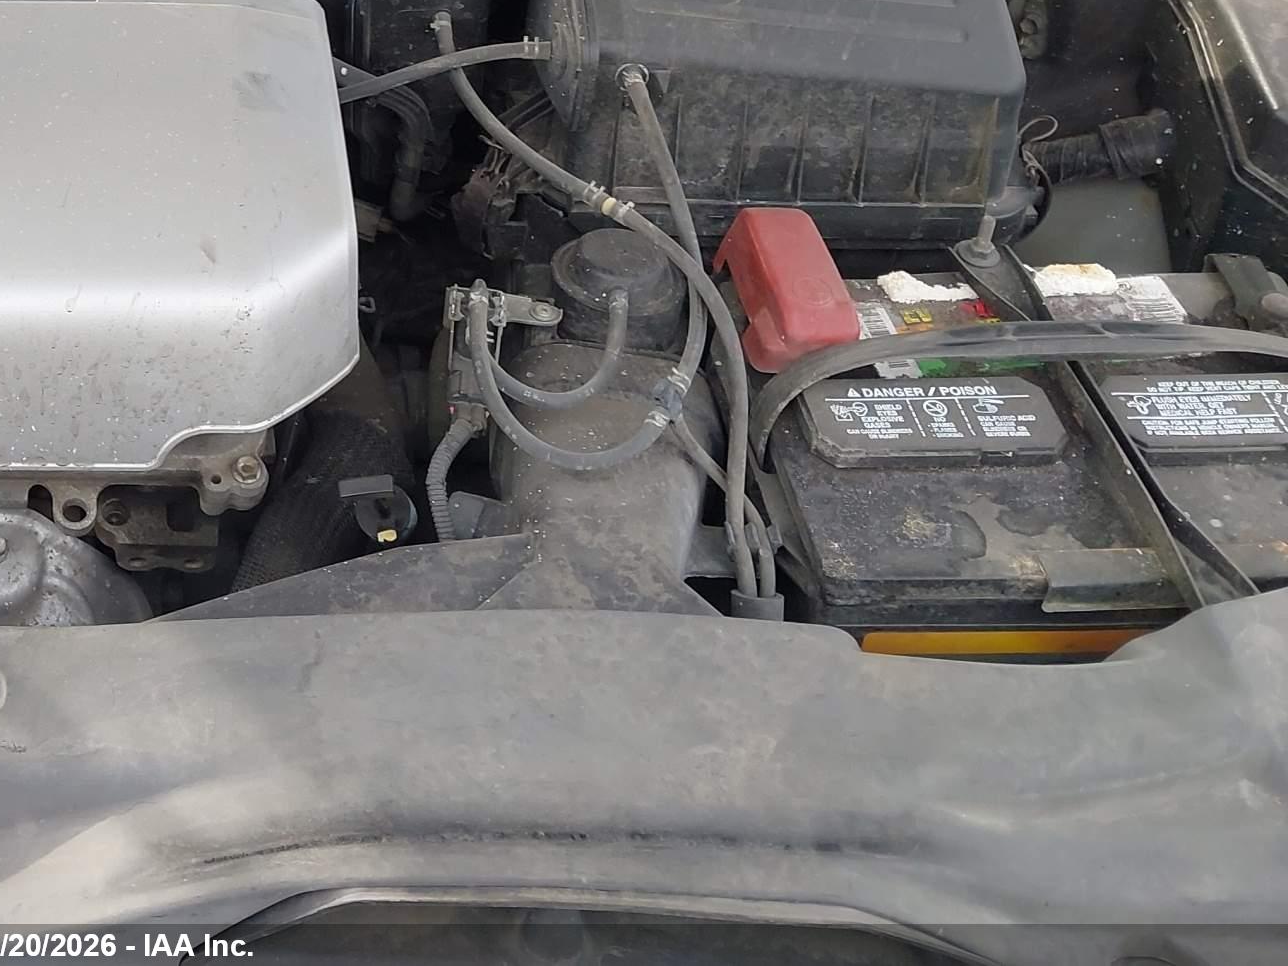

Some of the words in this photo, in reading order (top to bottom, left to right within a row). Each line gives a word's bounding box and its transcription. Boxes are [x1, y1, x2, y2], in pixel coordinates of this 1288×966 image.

[861, 387, 926, 398] DANGER
[927, 386, 938, 397] /
[939, 385, 997, 396] POISON
[1150, 396, 1178, 404] FLUSH
[1179, 395, 1200, 403] EYES
